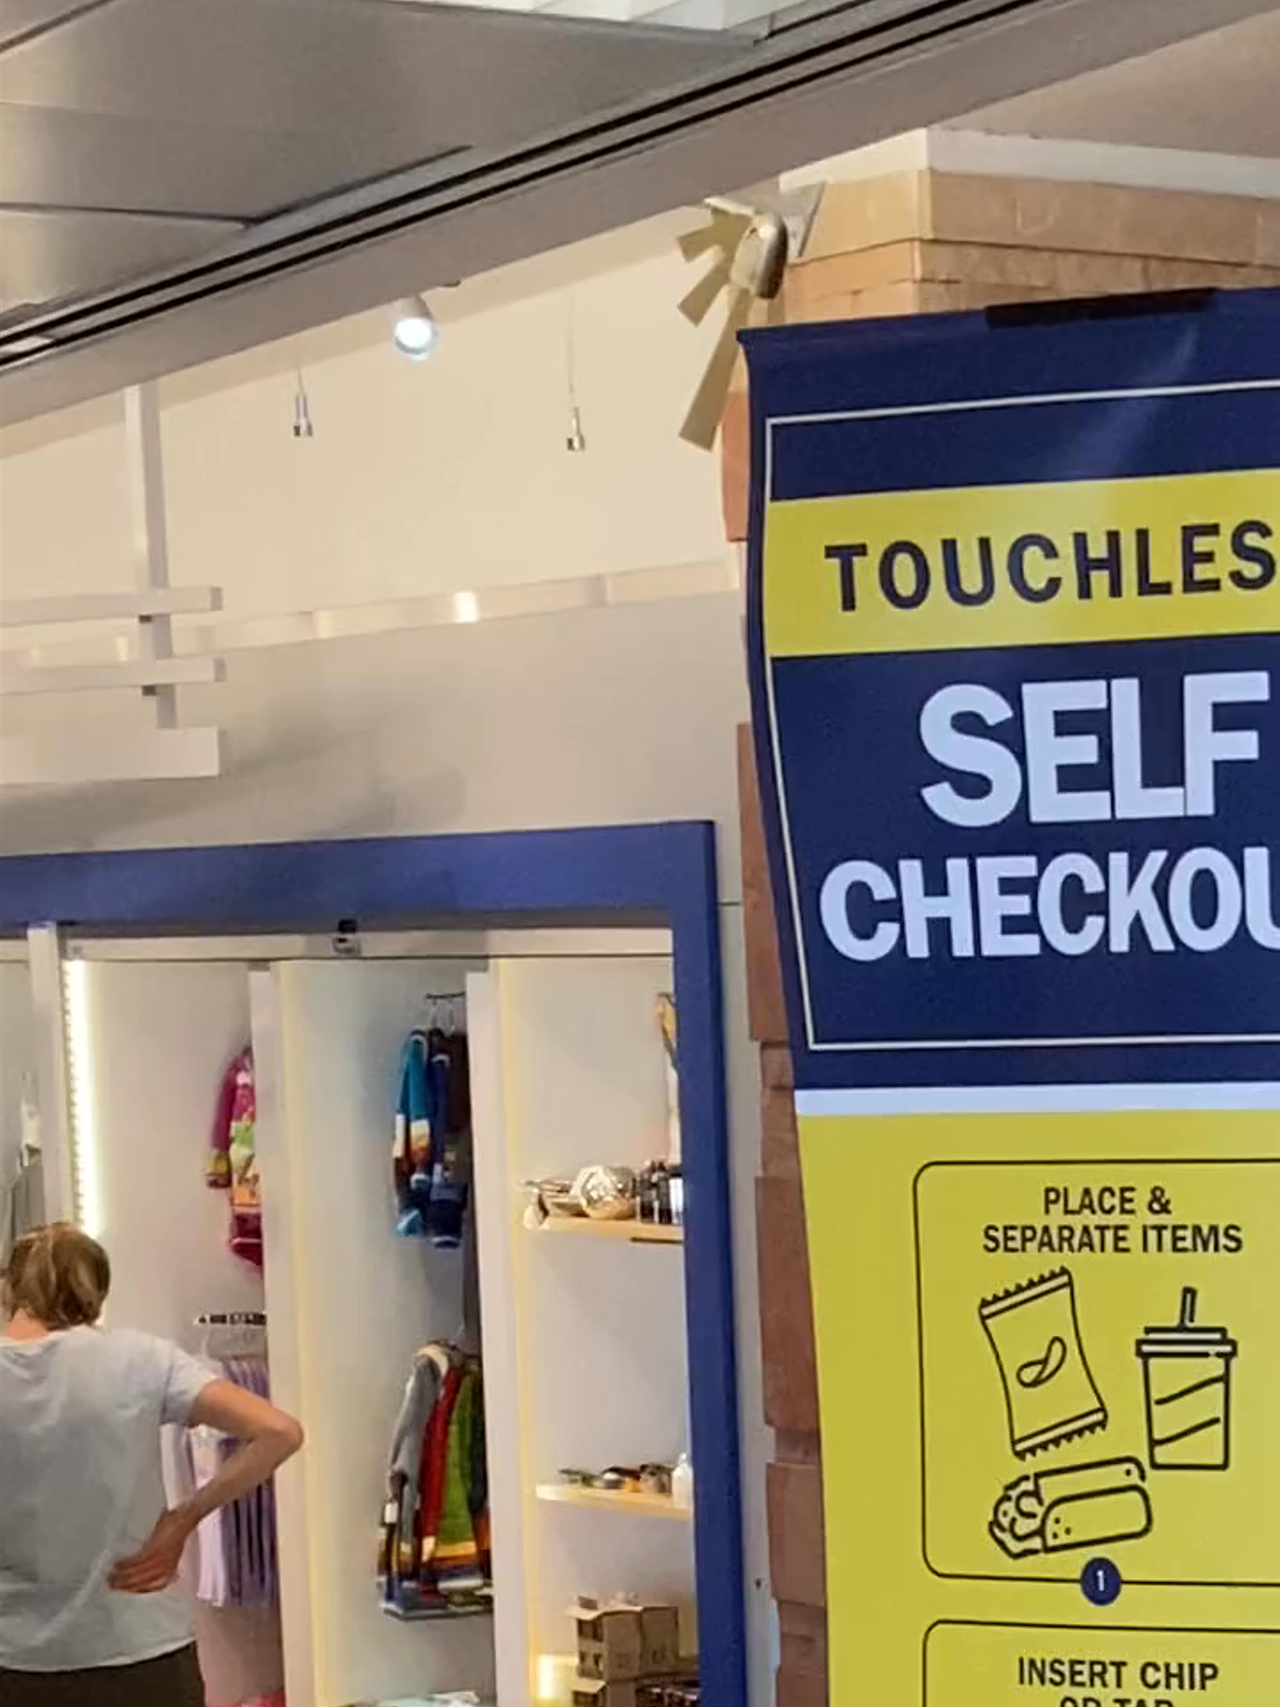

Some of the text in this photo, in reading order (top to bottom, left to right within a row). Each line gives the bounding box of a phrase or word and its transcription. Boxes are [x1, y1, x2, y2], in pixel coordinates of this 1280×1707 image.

[919, 670, 1270, 828] SELF
[1043, 1186, 1172, 1215] PLACE &
[983, 1223, 1243, 1254] SEPARATE ITEMS
[1096, 1570, 1106, 1592] 1
[1018, 1656, 1220, 1692] INSERT CHIP
